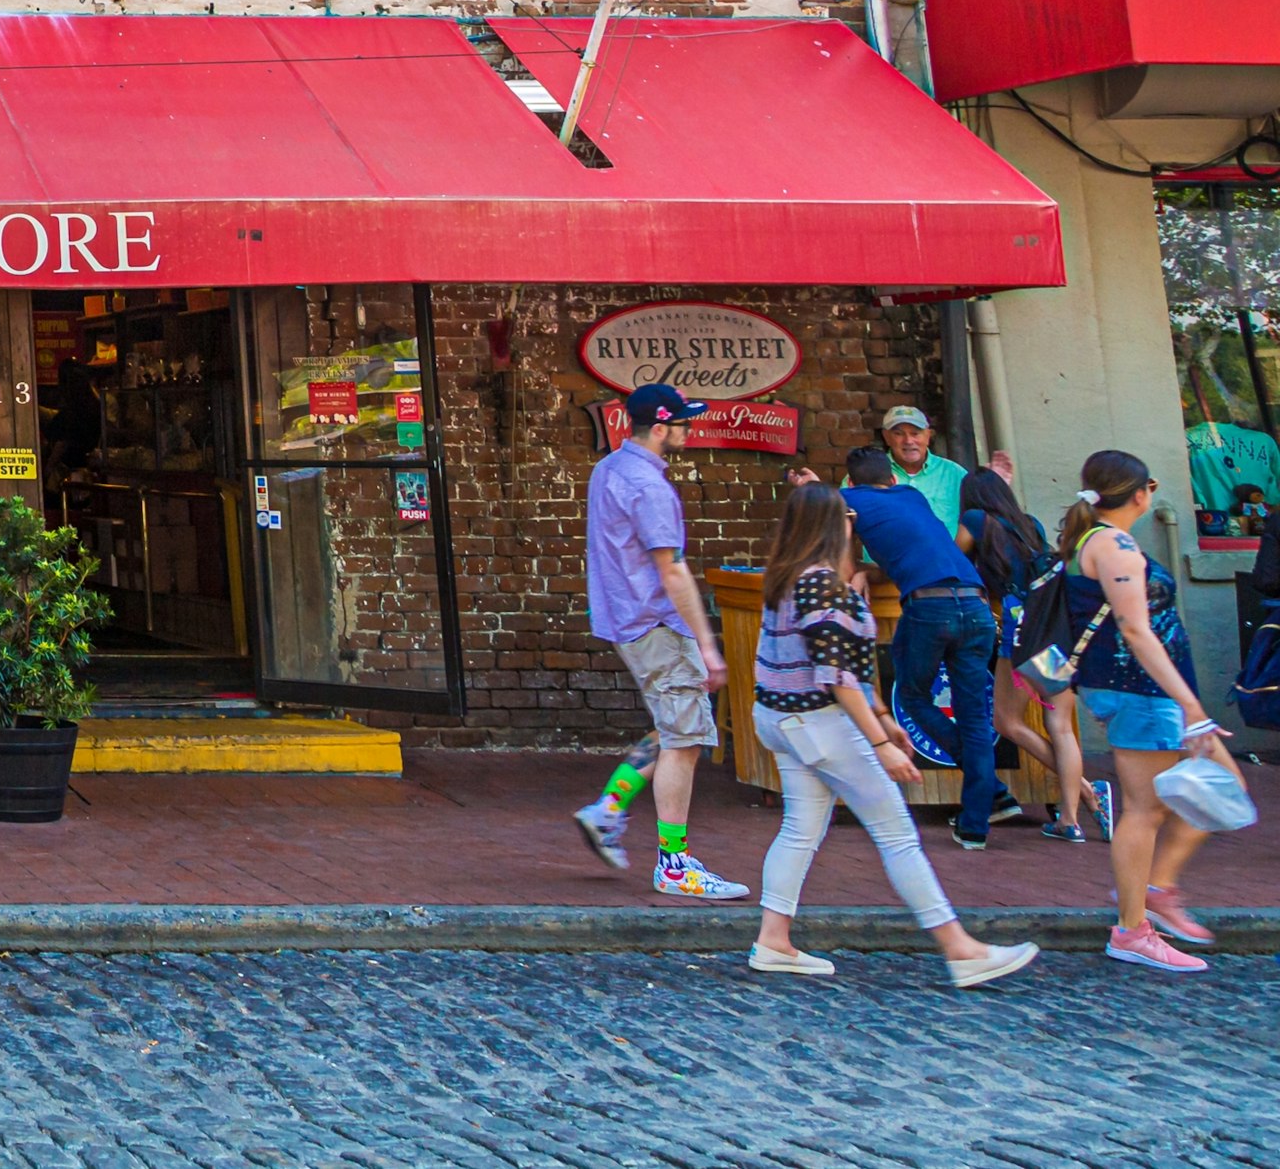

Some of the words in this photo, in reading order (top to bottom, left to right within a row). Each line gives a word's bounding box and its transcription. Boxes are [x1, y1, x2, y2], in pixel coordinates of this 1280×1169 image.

[625, 313, 689, 328] SAVANNAH
[698, 313, 754, 328] GEORGIA
[596, 338, 680, 360] RIVER
[689, 338, 786, 360] STREET
[728, 404, 794, 428] Pralines
[706, 429, 759, 441] HOMEMADE
[760, 431, 790, 445] FUDGE
[0, 466, 28, 475] STEP
[401, 510, 426, 519] PUSH
